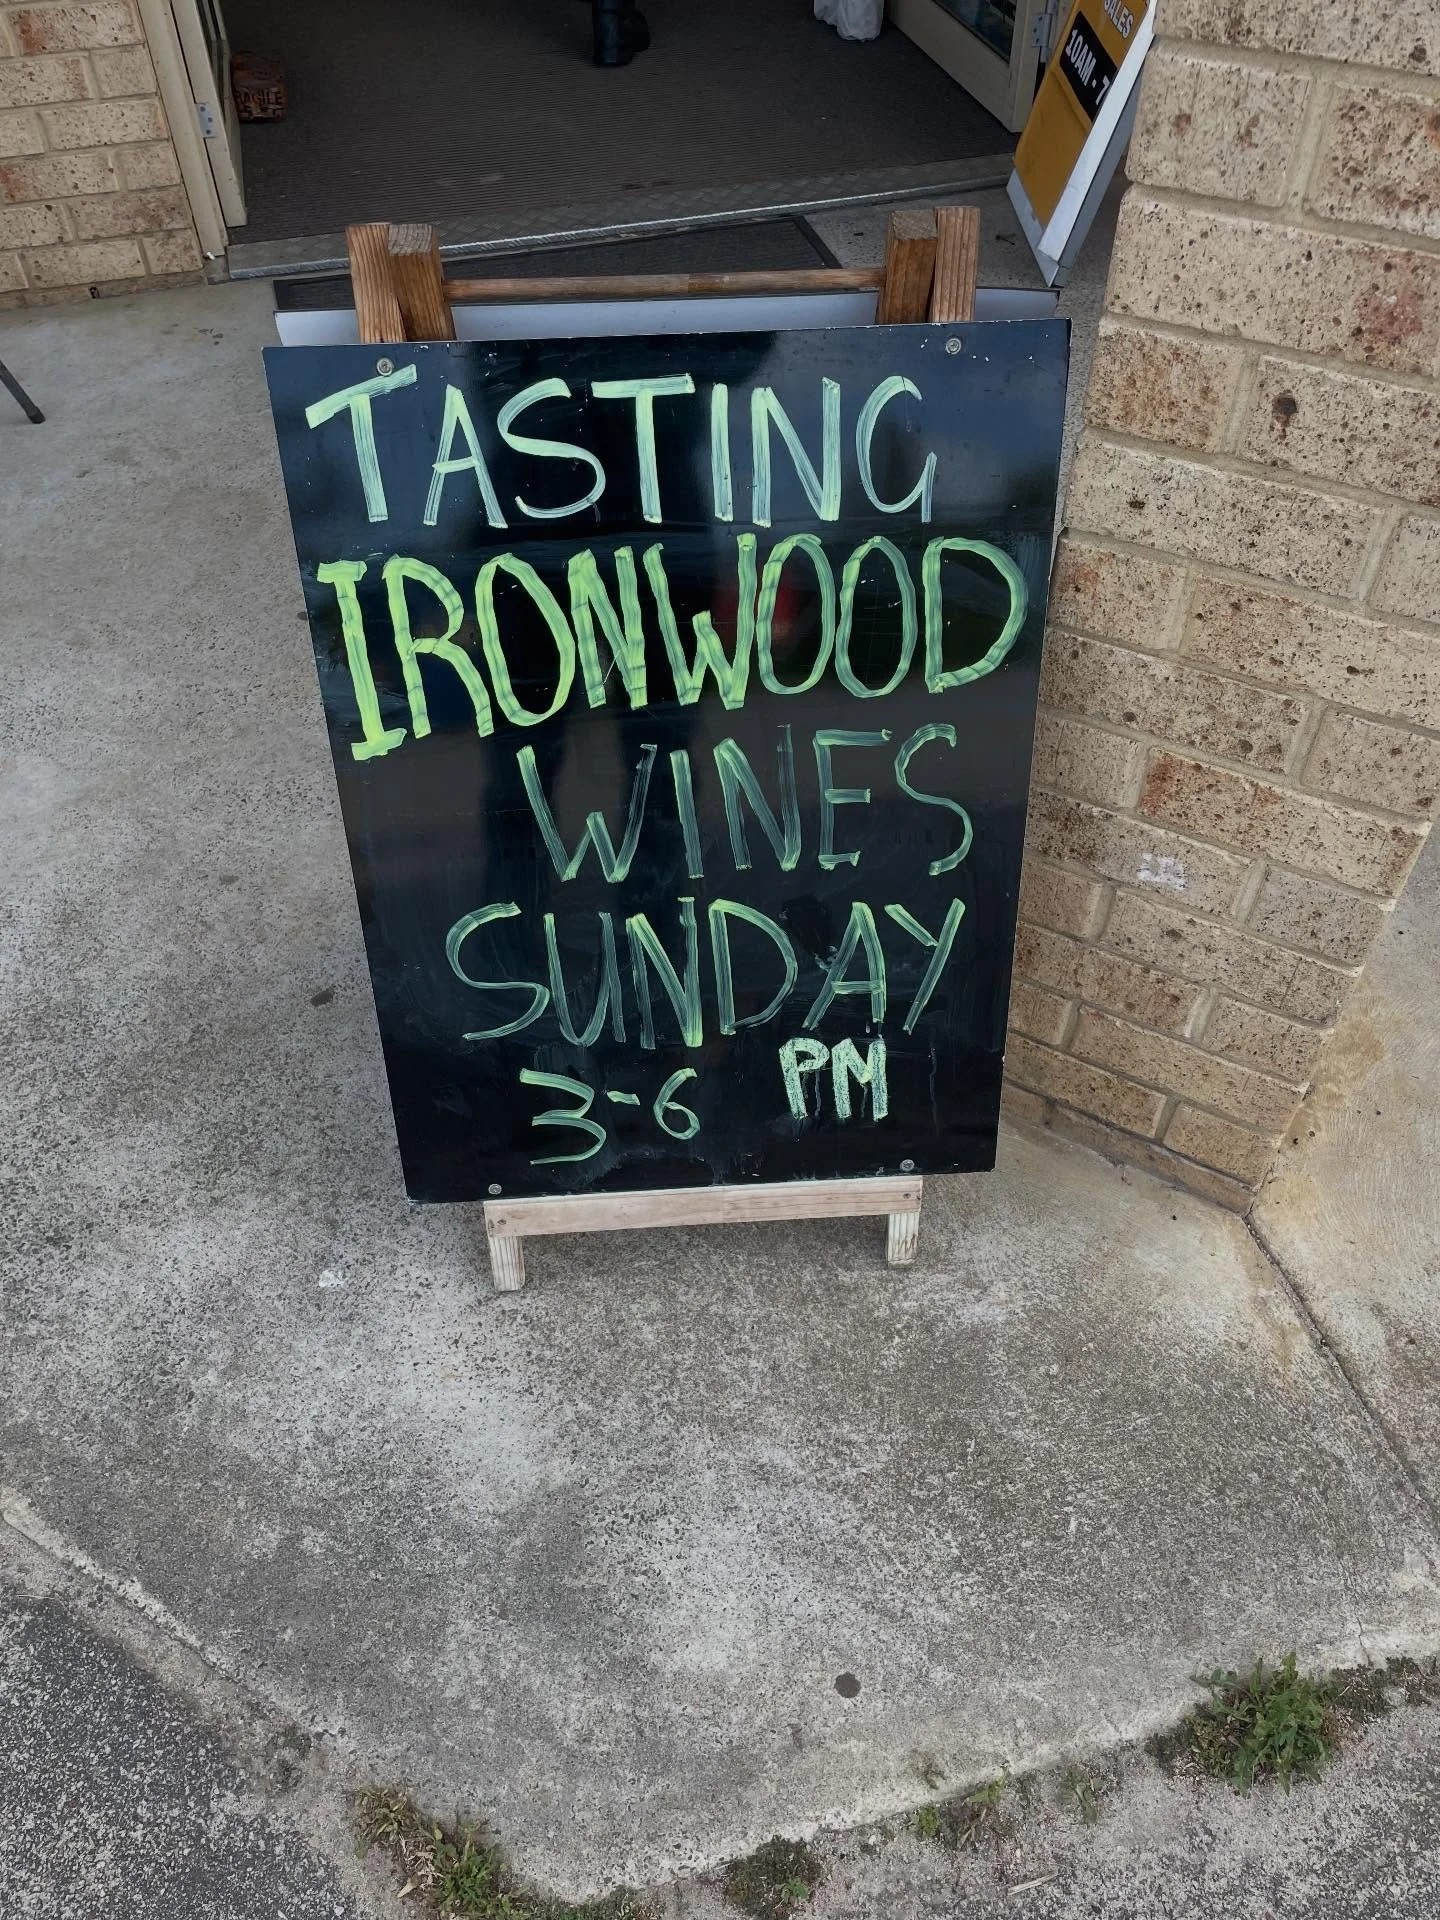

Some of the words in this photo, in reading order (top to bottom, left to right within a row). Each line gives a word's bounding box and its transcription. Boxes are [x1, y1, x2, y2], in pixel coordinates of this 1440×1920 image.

[1065, 29, 1097, 86] 10AM
[305, 363, 938, 529] TASTING
[317, 532, 1028, 762] IRONWOOD
[516, 723, 973, 883] WINES
[445, 896, 966, 1049] SUNDAY
[519, 1067, 700, 1164] 3-6
[778, 1037, 889, 1122] PM
